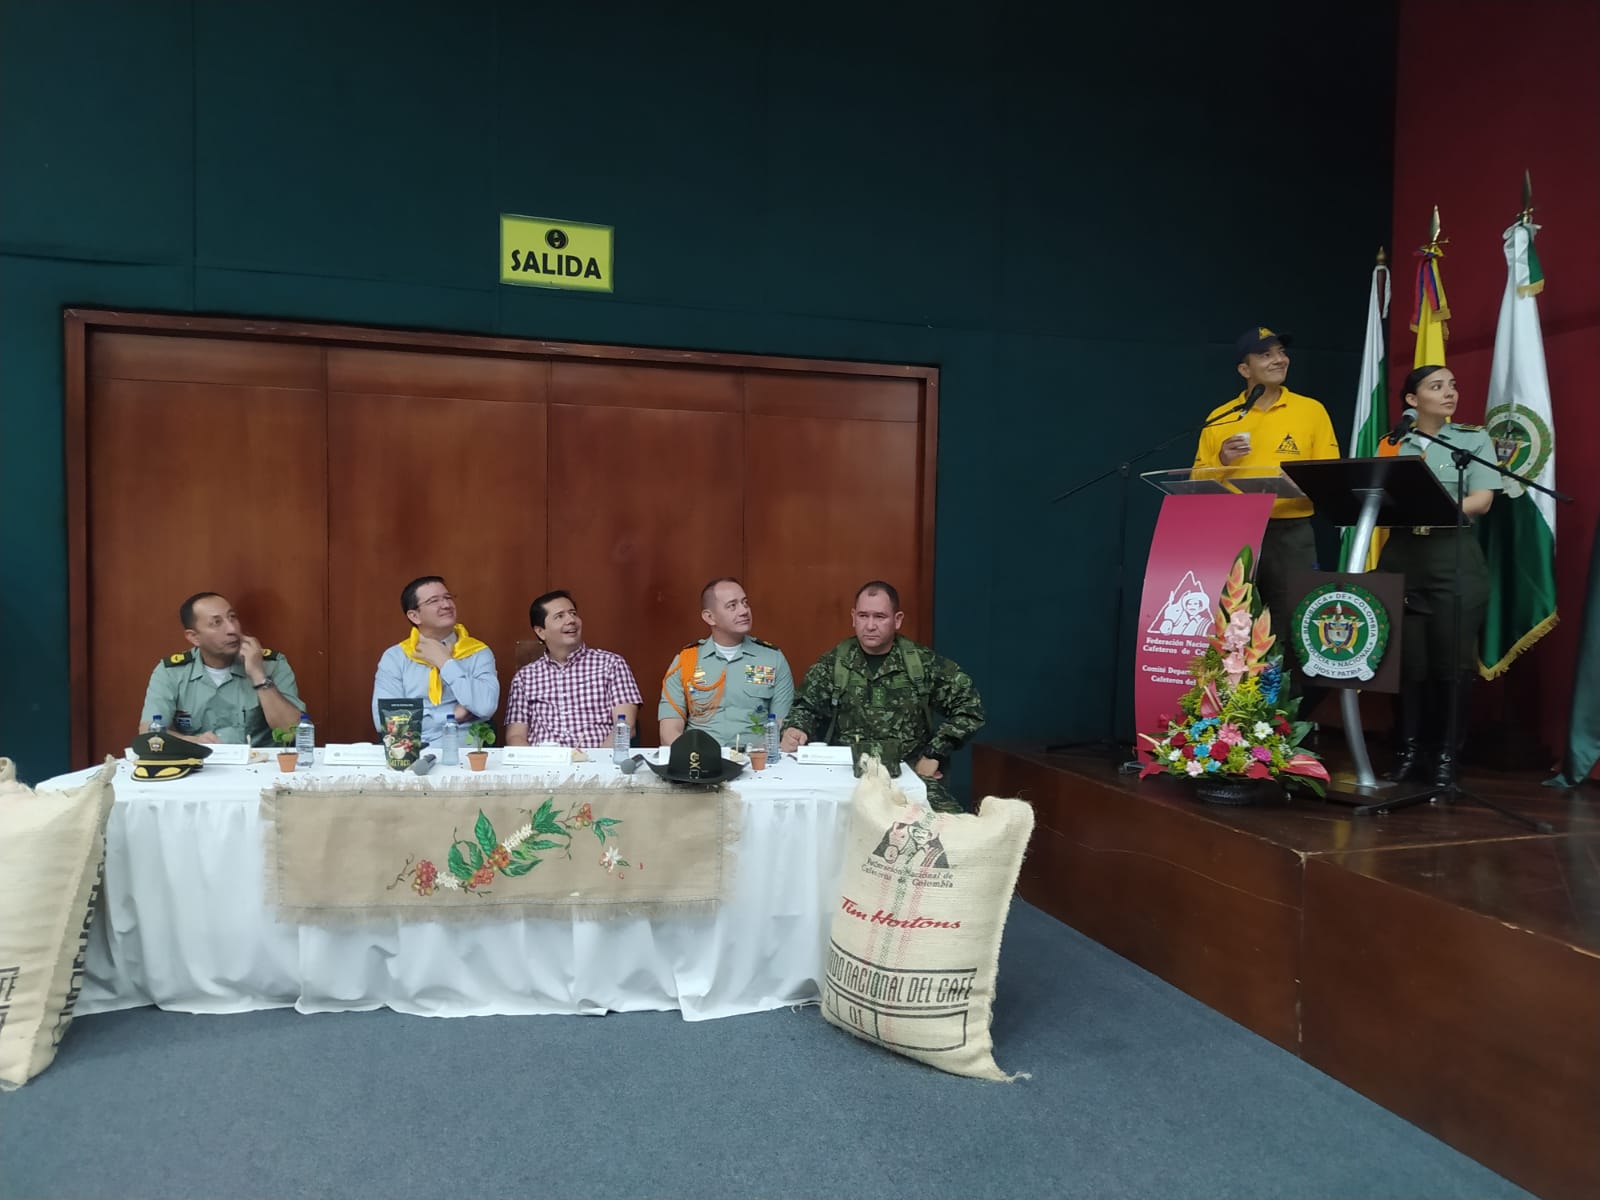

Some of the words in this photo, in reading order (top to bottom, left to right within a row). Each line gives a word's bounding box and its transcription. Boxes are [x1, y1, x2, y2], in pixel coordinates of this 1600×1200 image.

[511, 249, 602, 279] SALIDA
[1353, 598, 1377, 638] COLOMBIA
[1142, 644, 1177, 654] Cafeteros
[1181, 647, 1190, 655] de
[1337, 646, 1372, 667] NACIONAL
[1185, 678, 1197, 686] del
[1337, 667, 1363, 677] PATRIA
[911, 878, 954, 889] Colombia
[841, 896, 867, 920] Tim
[870, 910, 961, 929] Hortons
[843, 961, 904, 1003] NACIONAL
[906, 976, 933, 1003] DEL
